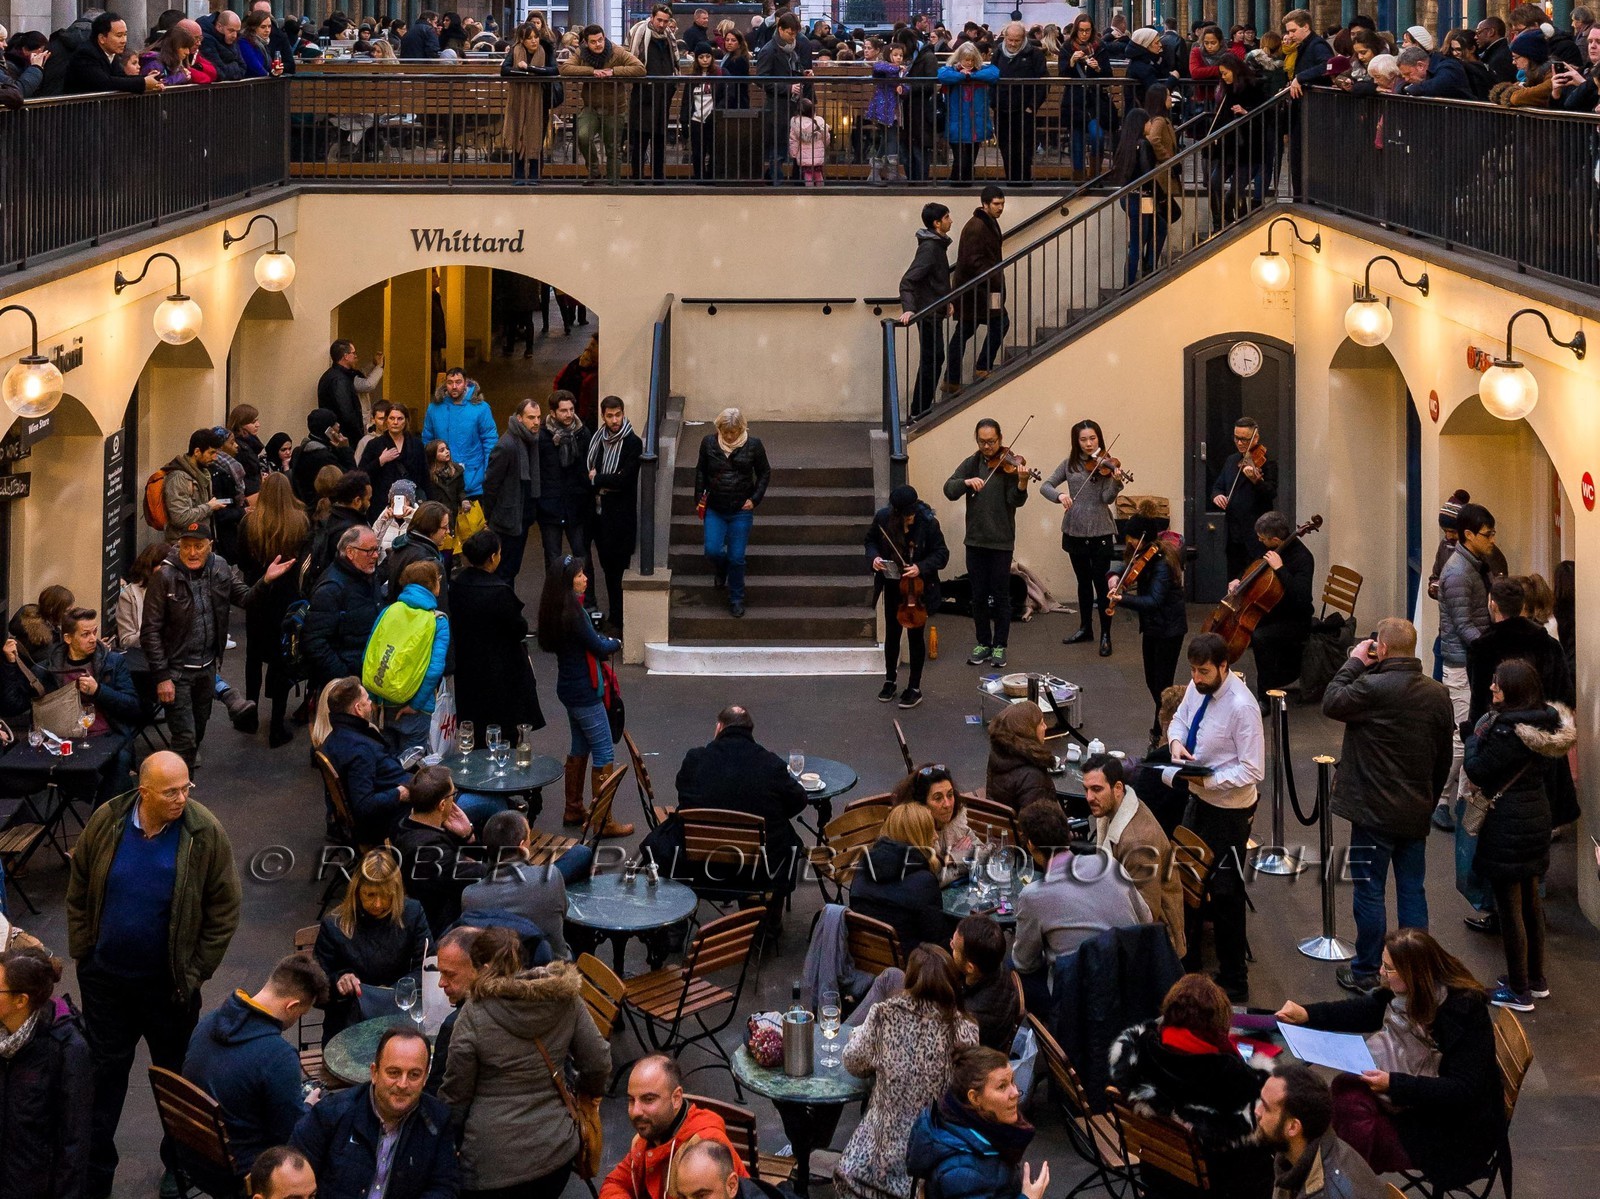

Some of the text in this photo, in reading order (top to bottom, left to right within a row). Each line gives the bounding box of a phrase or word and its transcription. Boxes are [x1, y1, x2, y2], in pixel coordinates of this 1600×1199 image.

[410, 228, 525, 253] Whittard
[28, 417, 50, 435] Wine Store
[1582, 481, 1594, 500] WC
